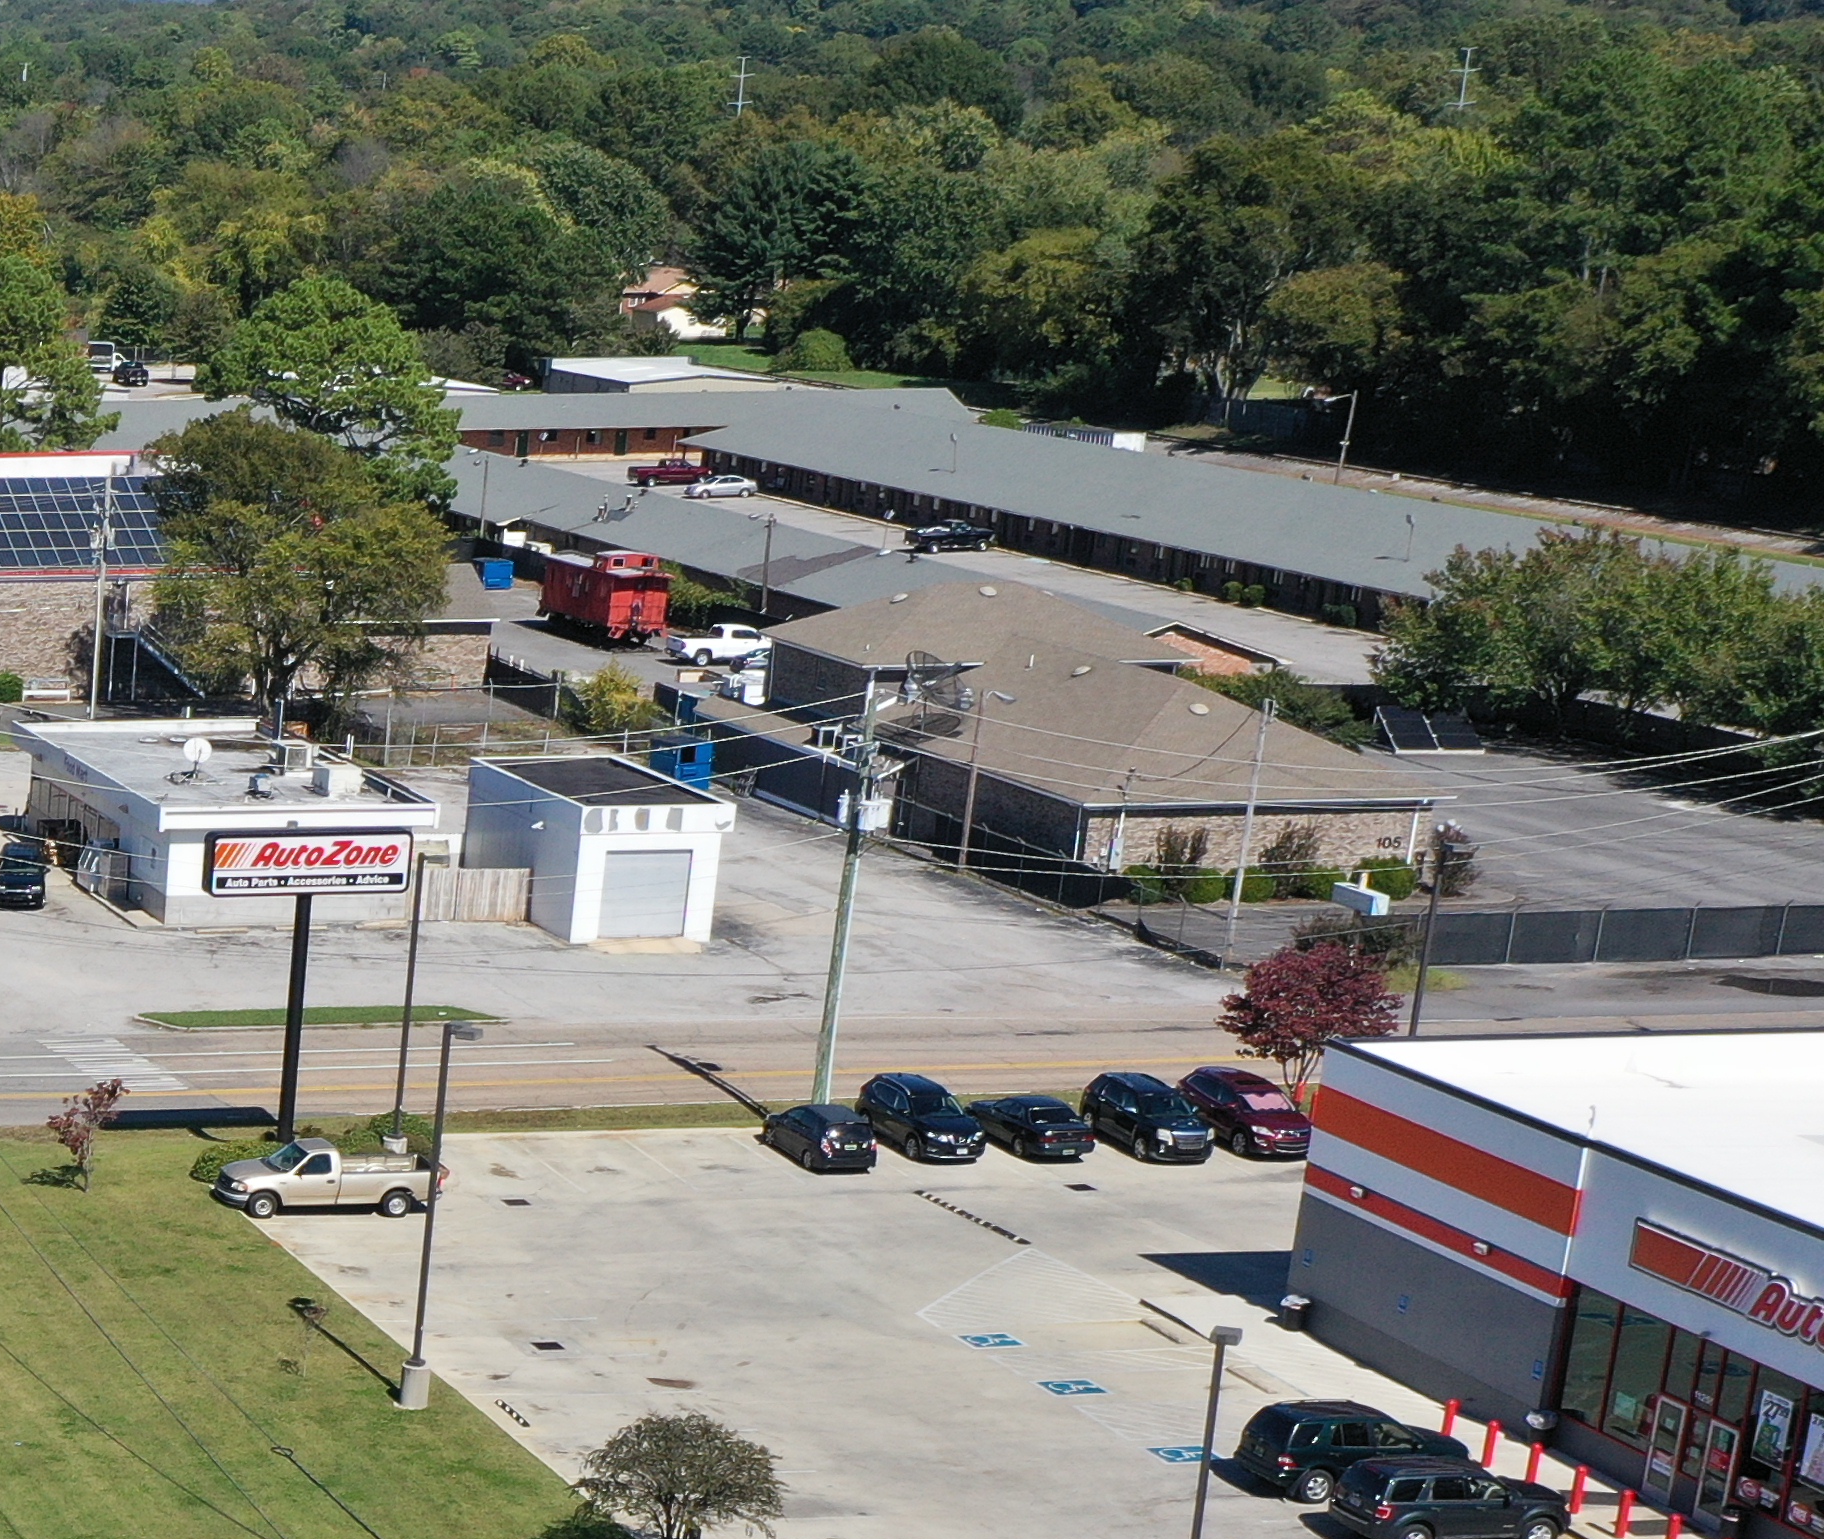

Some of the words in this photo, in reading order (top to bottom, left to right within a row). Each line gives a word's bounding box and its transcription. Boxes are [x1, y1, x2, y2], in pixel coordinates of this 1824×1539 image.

[1376, 836, 1402, 849] 105
[253, 840, 401, 867] AutoZone
[225, 877, 249, 887] Auto
[251, 877, 278, 887] Parts
[287, 876, 347, 886] Accessories
[356, 875, 389, 884] Advice
